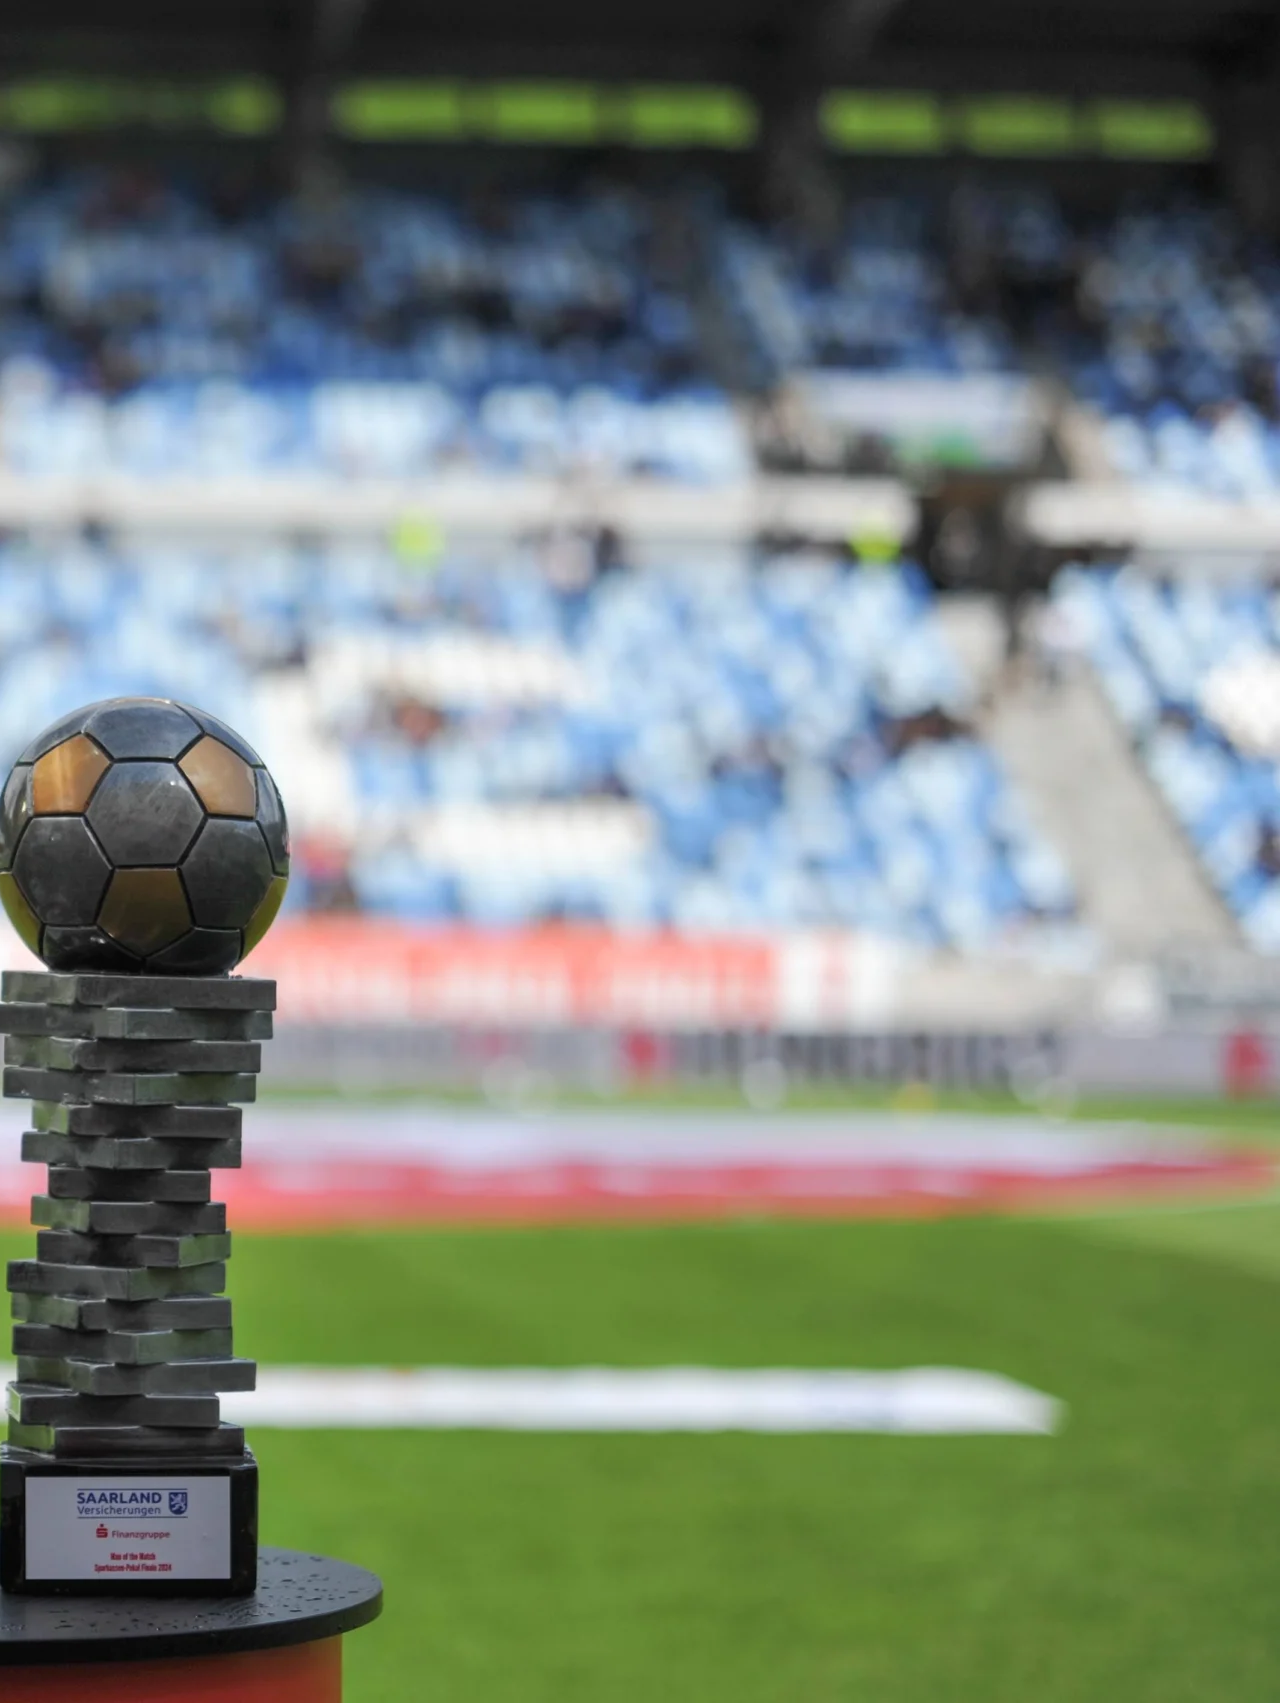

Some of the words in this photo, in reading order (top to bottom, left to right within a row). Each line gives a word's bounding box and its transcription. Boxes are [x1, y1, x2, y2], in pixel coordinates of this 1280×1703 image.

[77, 1492, 162, 1504] SAARLAND
[77, 1505, 161, 1516] Versicherungen
[111, 1530, 170, 1540] Finanzgruppe
[122, 1552, 128, 1560] of
[129, 1552, 138, 1560] the
[139, 1552, 156, 1560] Match
